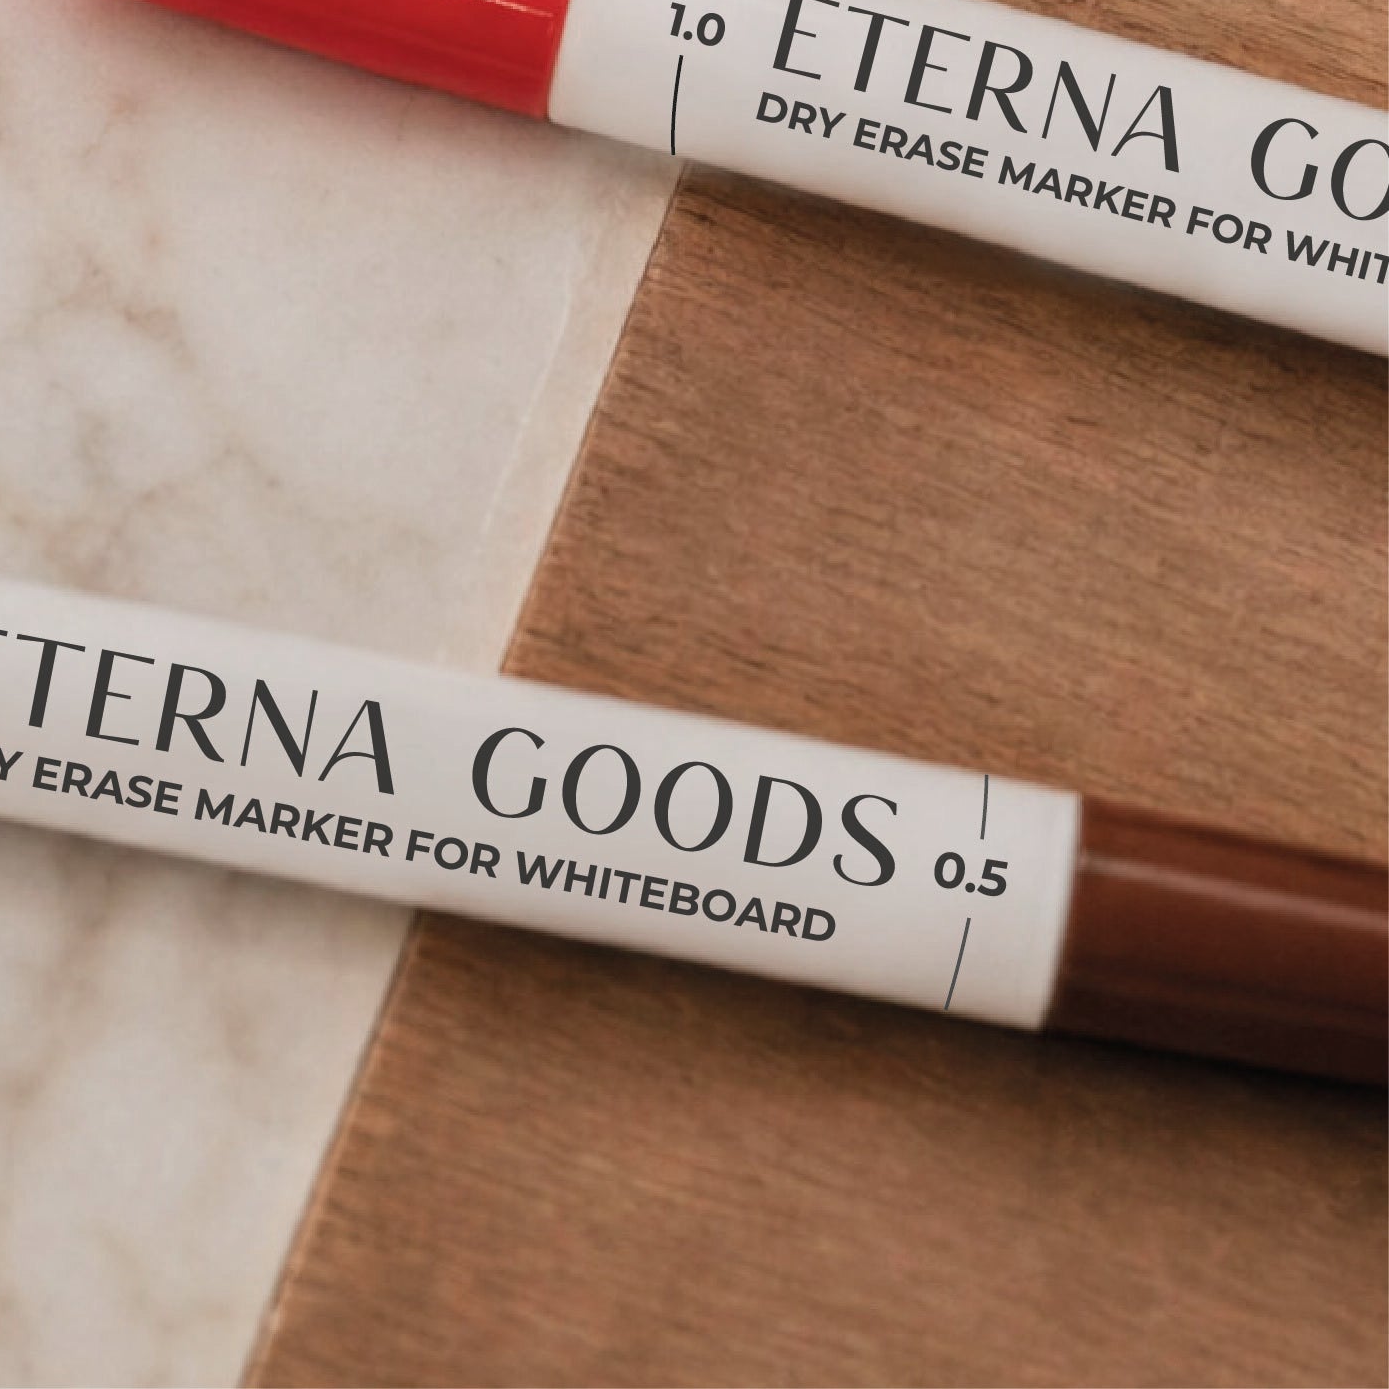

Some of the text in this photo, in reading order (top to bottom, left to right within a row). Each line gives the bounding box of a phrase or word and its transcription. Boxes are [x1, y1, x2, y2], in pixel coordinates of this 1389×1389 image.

[671, 3, 725, 46] 1.0
[756, 92, 846, 138] DRY
[853, 118, 988, 178] ERASE
[998, 156, 1175, 228] MARKER
[1186, 206, 1272, 254] FOR
[33, 757, 182, 815] ERASE
[195, 789, 393, 857] MARKER
[406, 830, 500, 878] FOR
[517, 851, 835, 941] WHITEBOARD
[472, 728, 897, 886] GOODS
[935, 852, 1008, 896] 0.5
